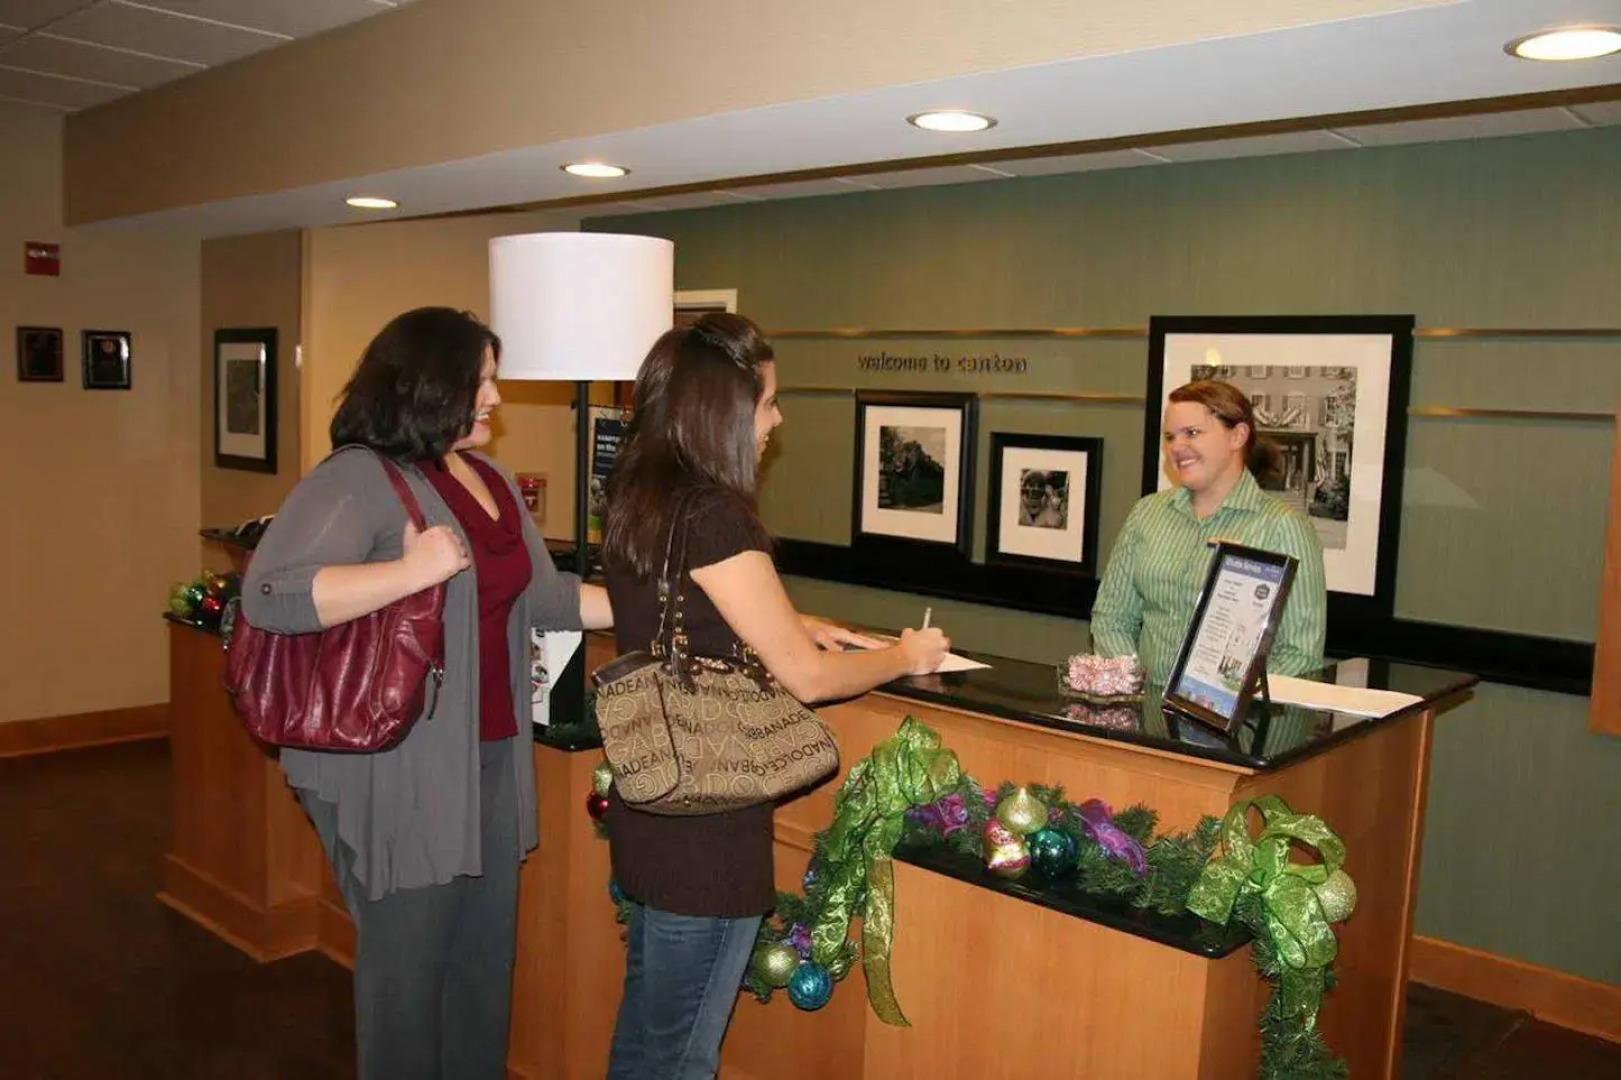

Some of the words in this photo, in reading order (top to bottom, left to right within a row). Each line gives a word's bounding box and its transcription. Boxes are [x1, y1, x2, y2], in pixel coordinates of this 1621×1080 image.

[856, 350, 929, 371] welcome
[933, 352, 950, 372] to
[957, 353, 1028, 373] canton
